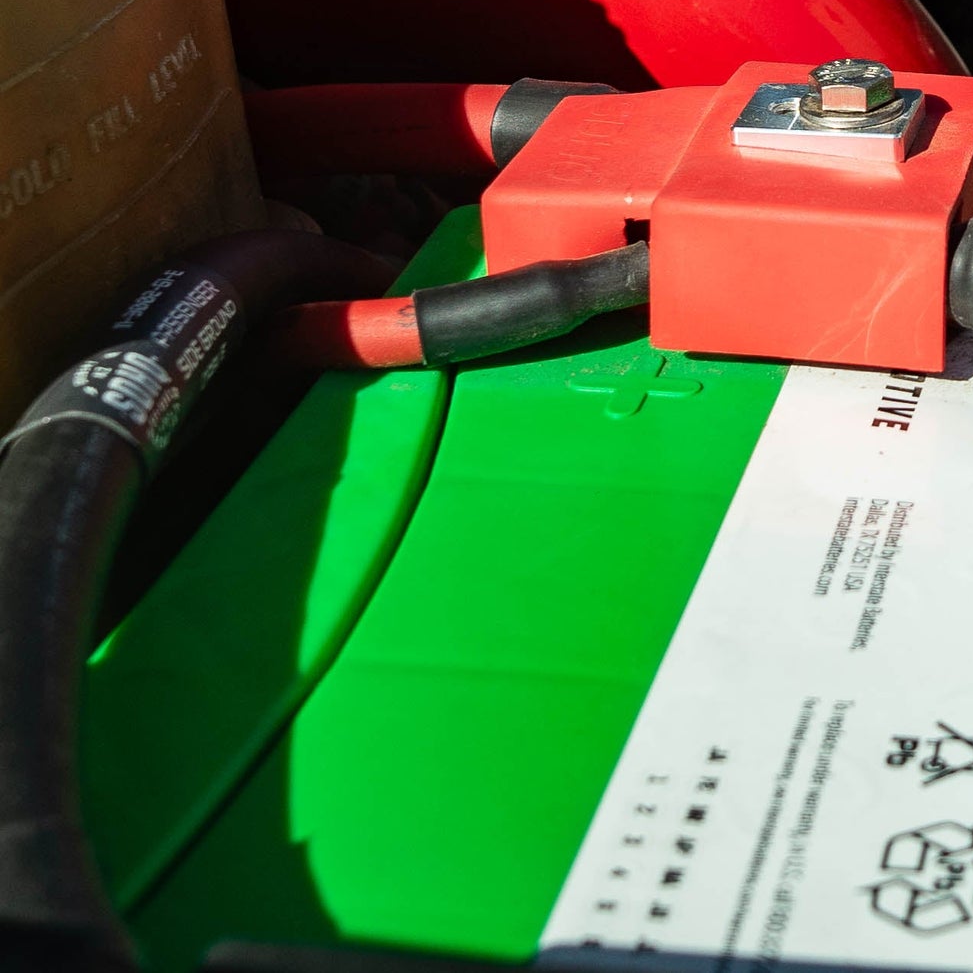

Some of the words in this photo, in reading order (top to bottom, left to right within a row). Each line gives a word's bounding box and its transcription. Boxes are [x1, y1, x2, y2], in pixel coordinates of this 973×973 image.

[151, 279, 220, 347] PASSENGER
[861, 499, 889, 526] Dallas,
[885, 500, 914, 548] Distributed
[814, 496, 862, 596] interstatebatteries.com
[860, 529, 880, 539] TX
[851, 541, 877, 569] 75251
[877, 549, 901, 560] by
[842, 572, 865, 592] USA
[865, 562, 896, 605] Interstate
[885, 736, 919, 767] Pb
